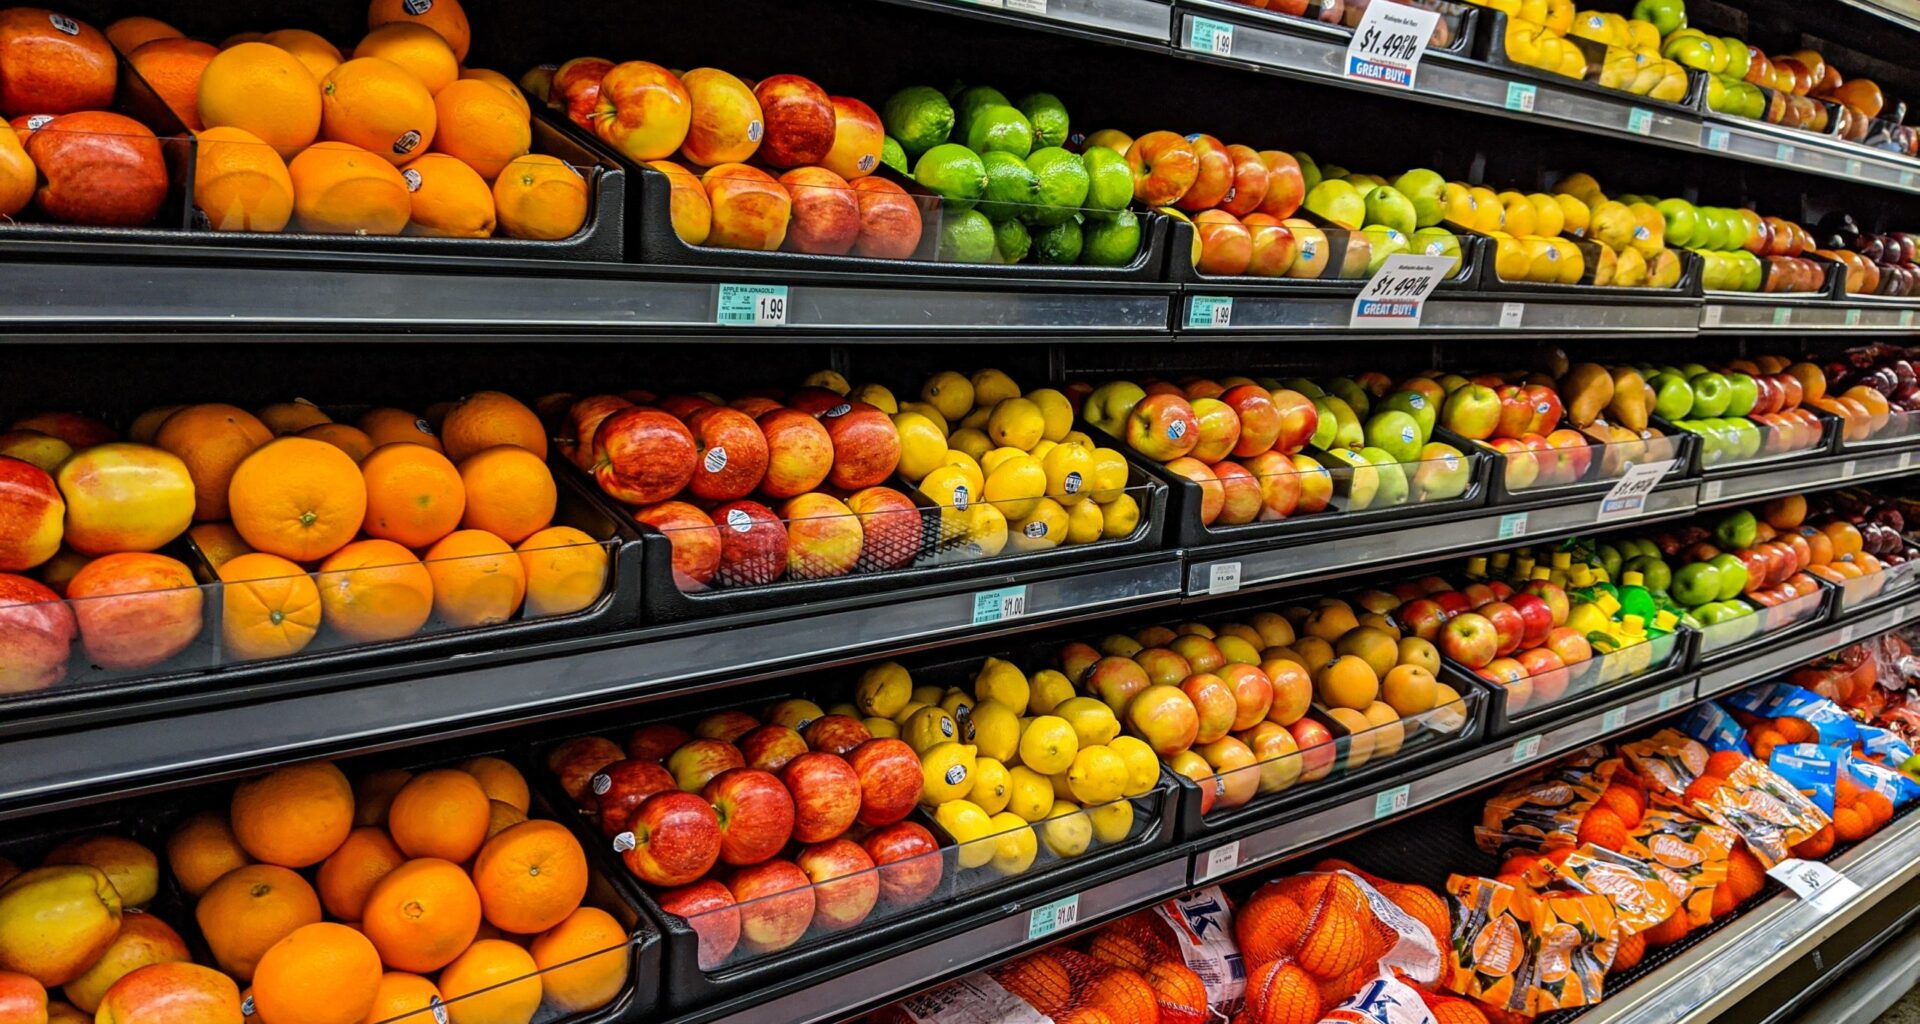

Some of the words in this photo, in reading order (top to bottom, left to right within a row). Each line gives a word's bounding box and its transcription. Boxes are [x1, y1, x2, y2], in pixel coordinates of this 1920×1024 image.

[1216, 34, 1230, 53] 1.99
[1360, 26, 1403, 57] $1.49
[1356, 62, 1385, 78] GREAT
[1385, 67, 1406, 83] BUY!
[1372, 275, 1416, 296] $1.49
[760, 298, 784, 320] 1.99
[1215, 307, 1229, 323] 1.99
[1363, 303, 1391, 314] GREAT
[1391, 304, 1413, 315] BUY!
